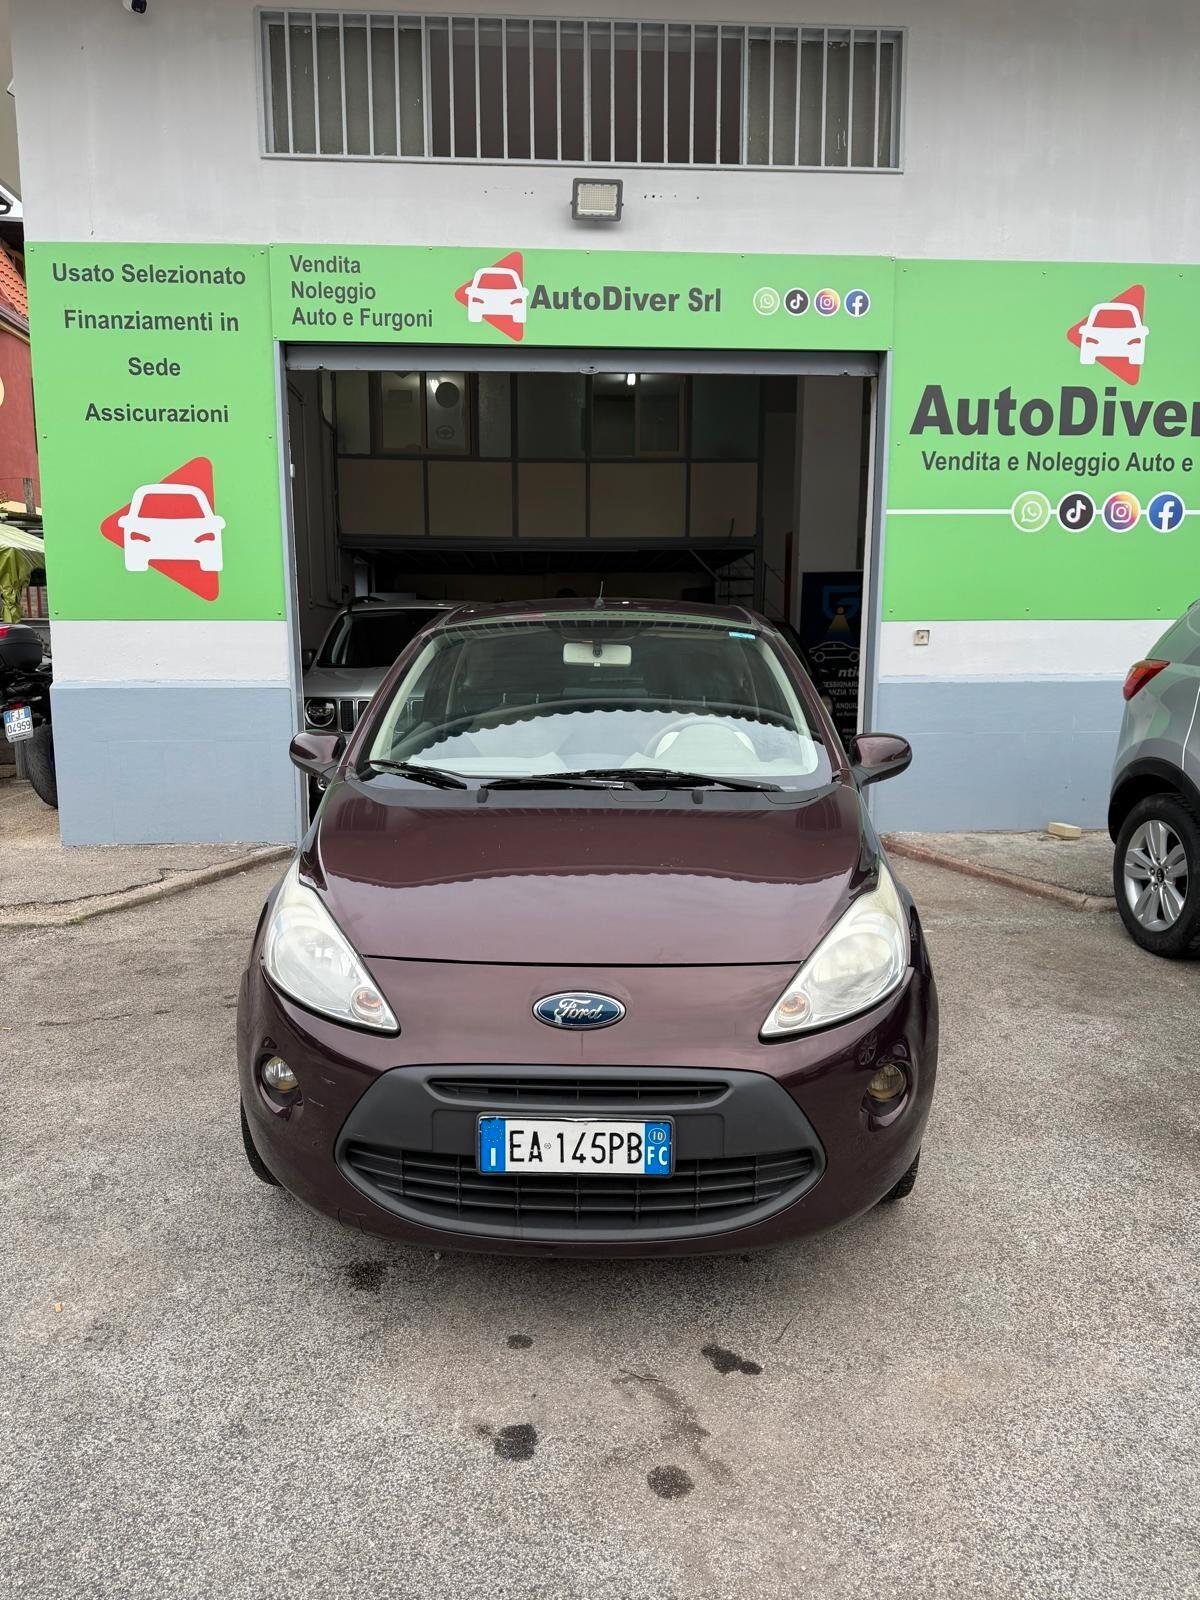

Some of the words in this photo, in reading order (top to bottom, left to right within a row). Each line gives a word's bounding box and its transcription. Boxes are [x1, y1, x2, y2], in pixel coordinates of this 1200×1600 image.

[52, 263, 115, 282] Usato
[121, 264, 246, 284] Selezionato
[289, 254, 361, 273] Vendita
[291, 281, 376, 304] Noleggio
[530, 284, 680, 312] AutoDiver
[688, 287, 721, 312] Srl
[64, 309, 213, 331] Finanziamenti
[220, 312, 239, 331] in
[292, 307, 337, 326] Auto
[343, 311, 353, 326] e
[360, 308, 433, 331] Furgoni
[128, 357, 181, 376] Sede
[85, 403, 229, 423] Assicurazioni
[921, 450, 1001, 471] Vendita
[1007, 455, 1019, 472] e
[1026, 451, 1120, 477] Noleggio
[1125, 452, 1175, 472] Auto
[1181, 456, 1193, 472] e
[554, 998, 604, 1020] Ford
[509, 1130, 543, 1163] EA
[556, 1132, 643, 1164] 145PB
[647, 1146, 668, 1166] FC
